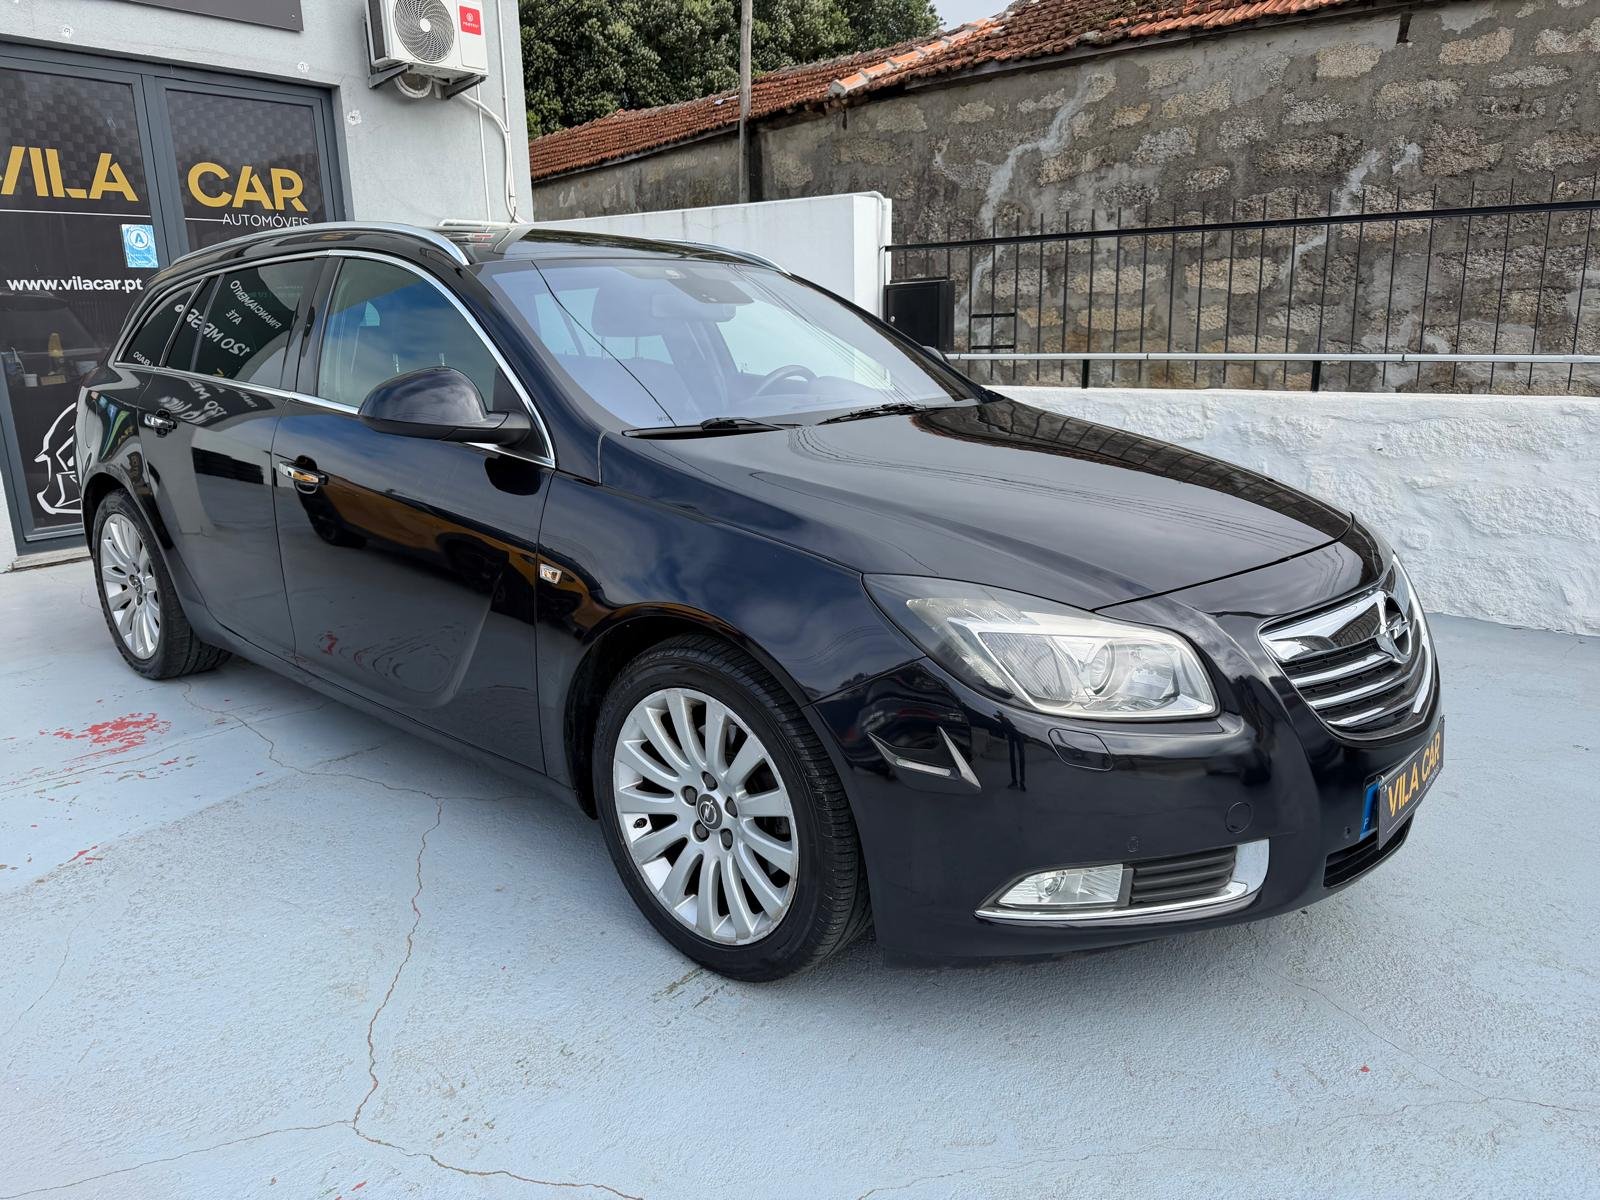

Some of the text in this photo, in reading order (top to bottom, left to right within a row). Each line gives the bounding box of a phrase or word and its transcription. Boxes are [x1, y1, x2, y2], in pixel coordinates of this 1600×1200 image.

[187, 161, 309, 212] CAR
[222, 212, 310, 228] AUTOMÓVEIS
[6, 275, 144, 294] www.vilacar.pt
[1388, 761, 1419, 817] VILA
[1421, 731, 1441, 783] CAR
